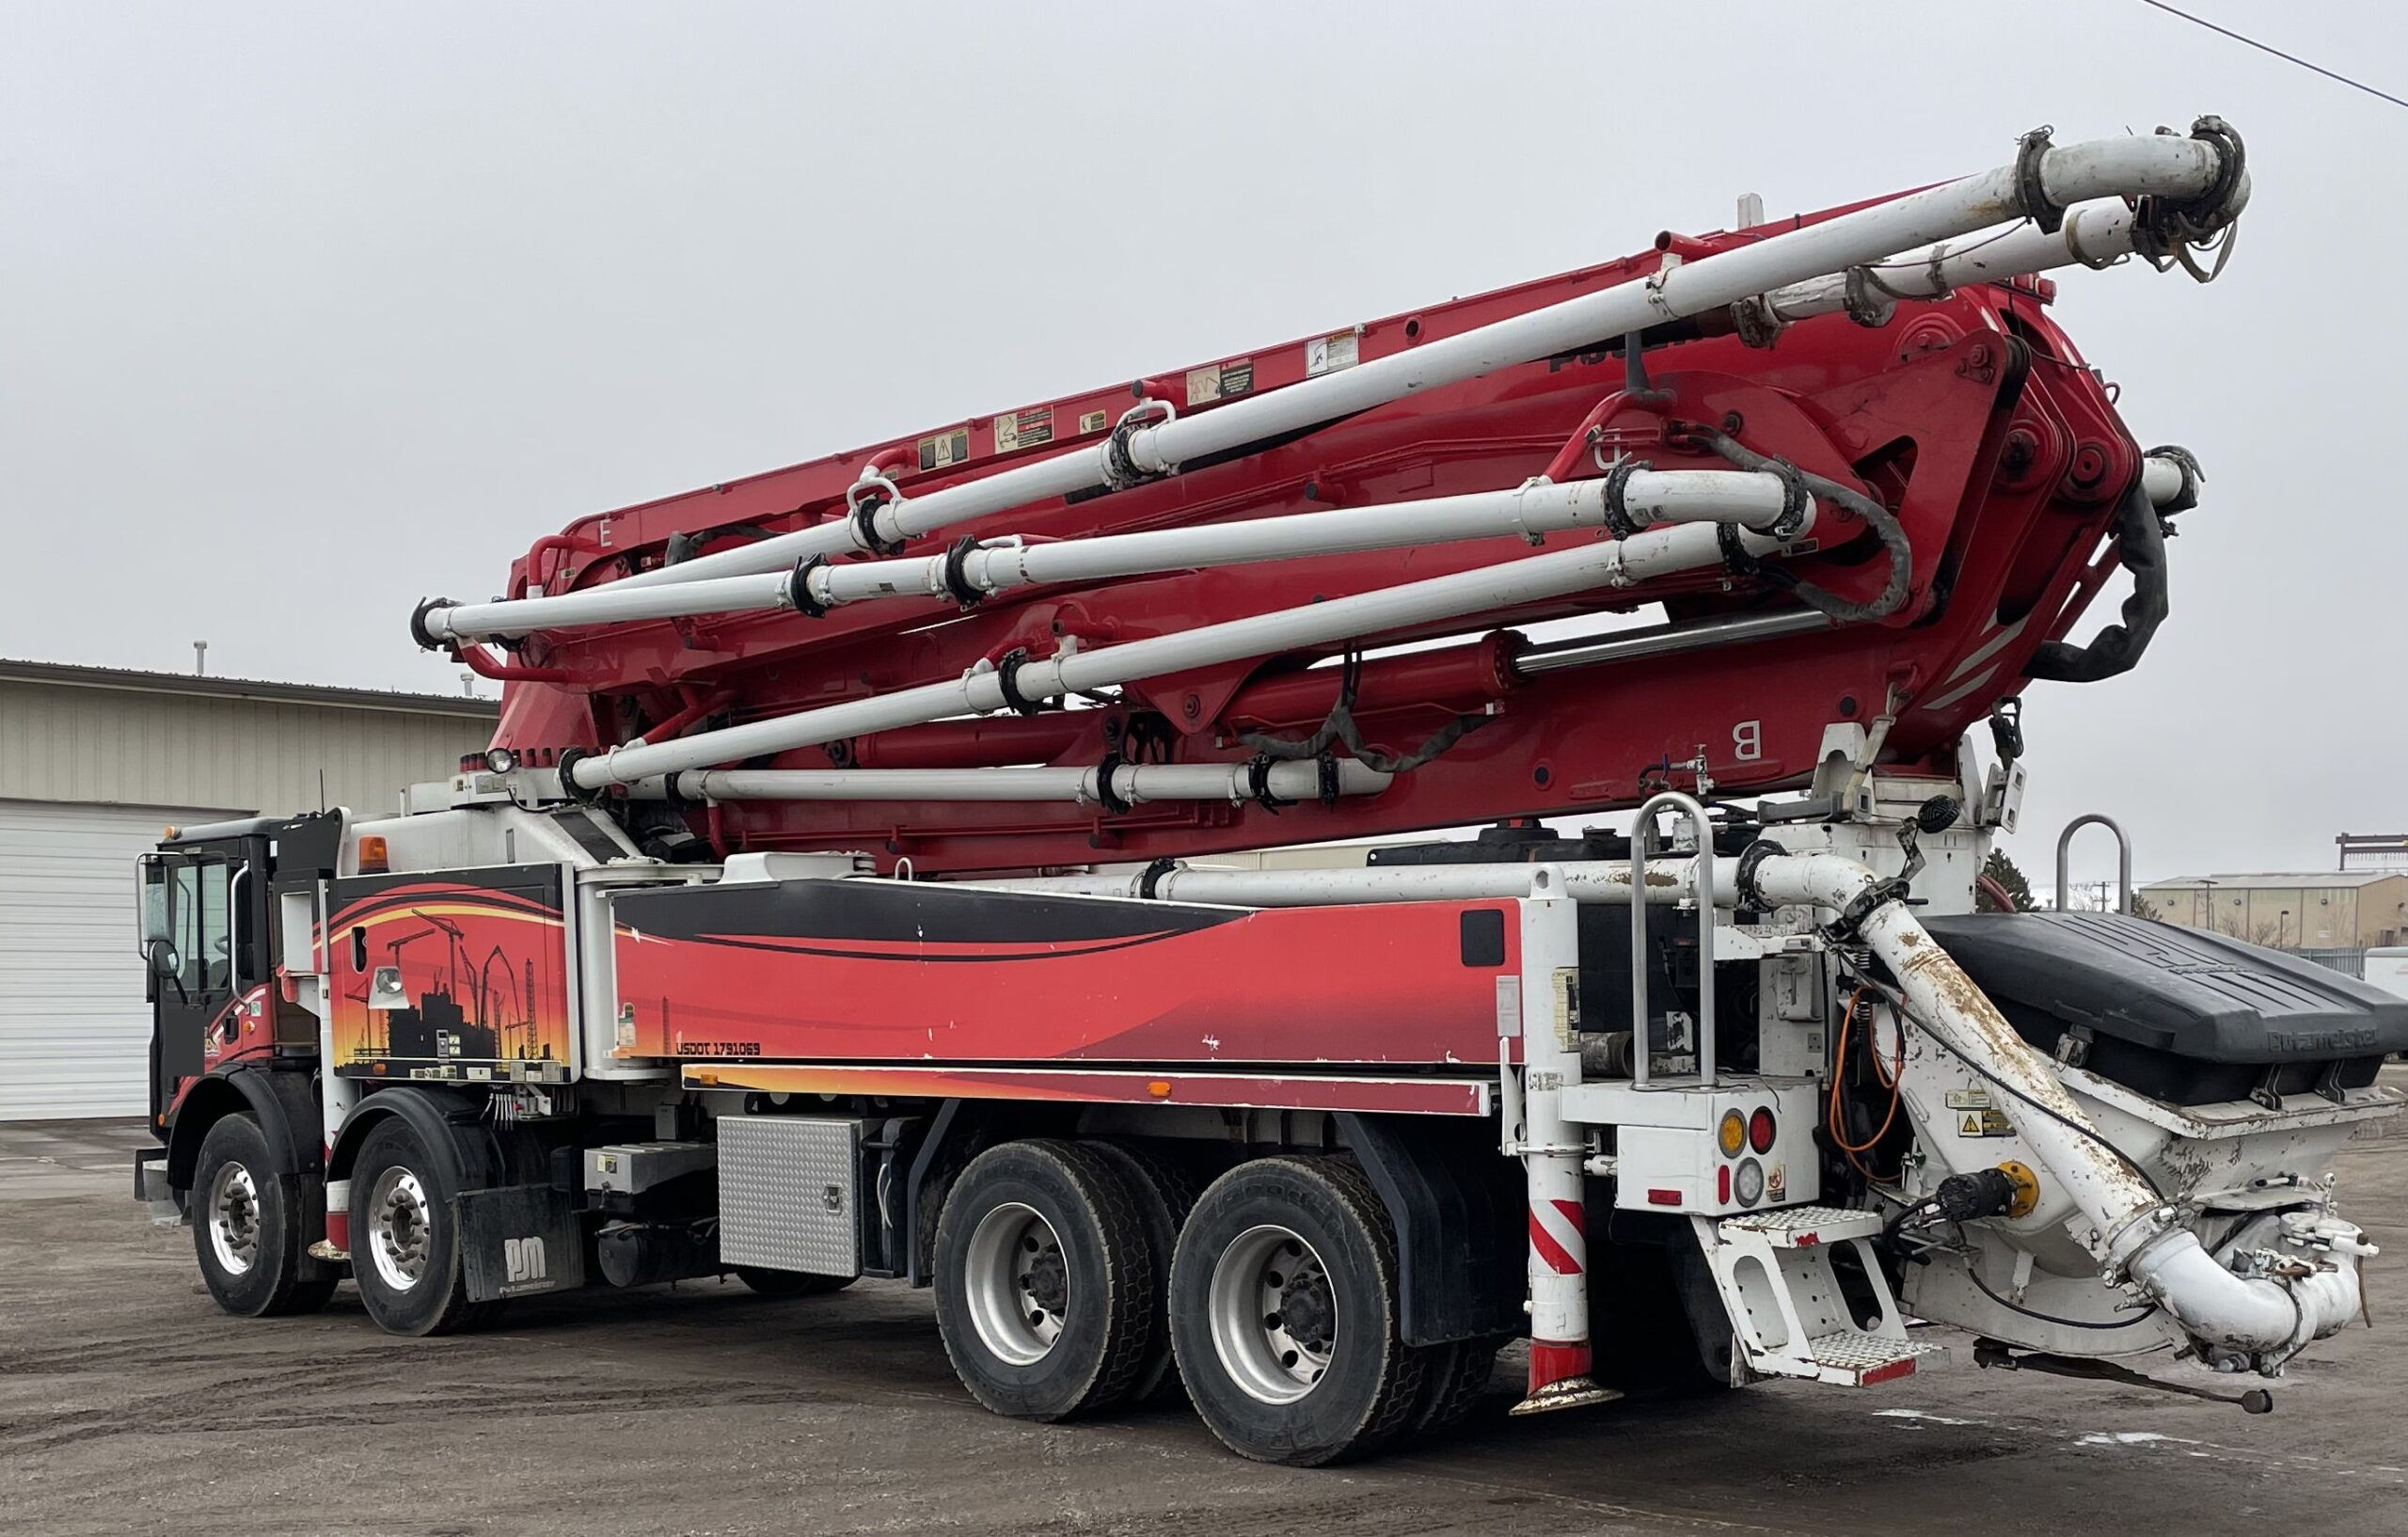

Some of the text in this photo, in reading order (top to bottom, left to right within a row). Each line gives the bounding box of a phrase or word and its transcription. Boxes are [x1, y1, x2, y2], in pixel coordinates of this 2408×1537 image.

[600, 518, 612, 547] E
[1732, 720, 1762, 761] B
[676, 1042, 760, 1055] USDOT 1791069
